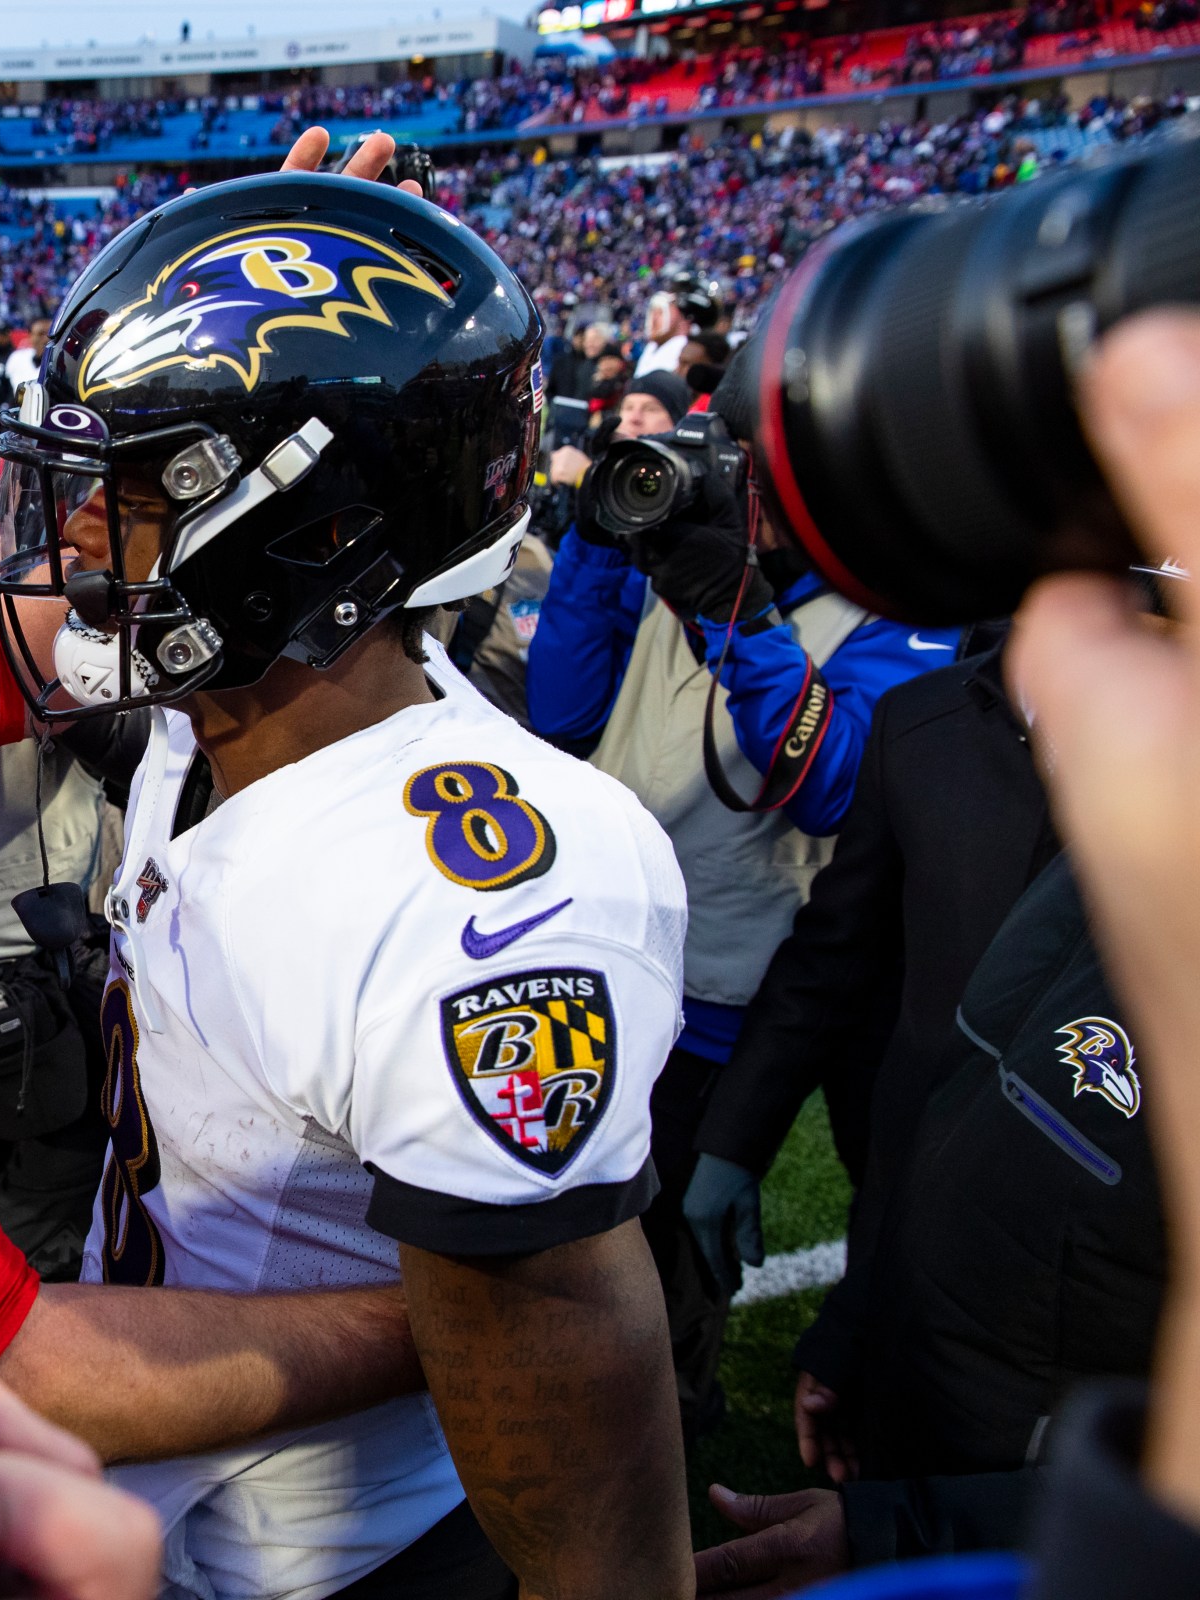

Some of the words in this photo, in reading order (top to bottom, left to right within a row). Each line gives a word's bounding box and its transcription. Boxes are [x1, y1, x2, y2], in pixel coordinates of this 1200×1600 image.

[676, 428, 705, 440] Canon
[784, 682, 827, 759] Canon
[402, 760, 557, 892] 8
[451, 977, 596, 1020] RAVENS
